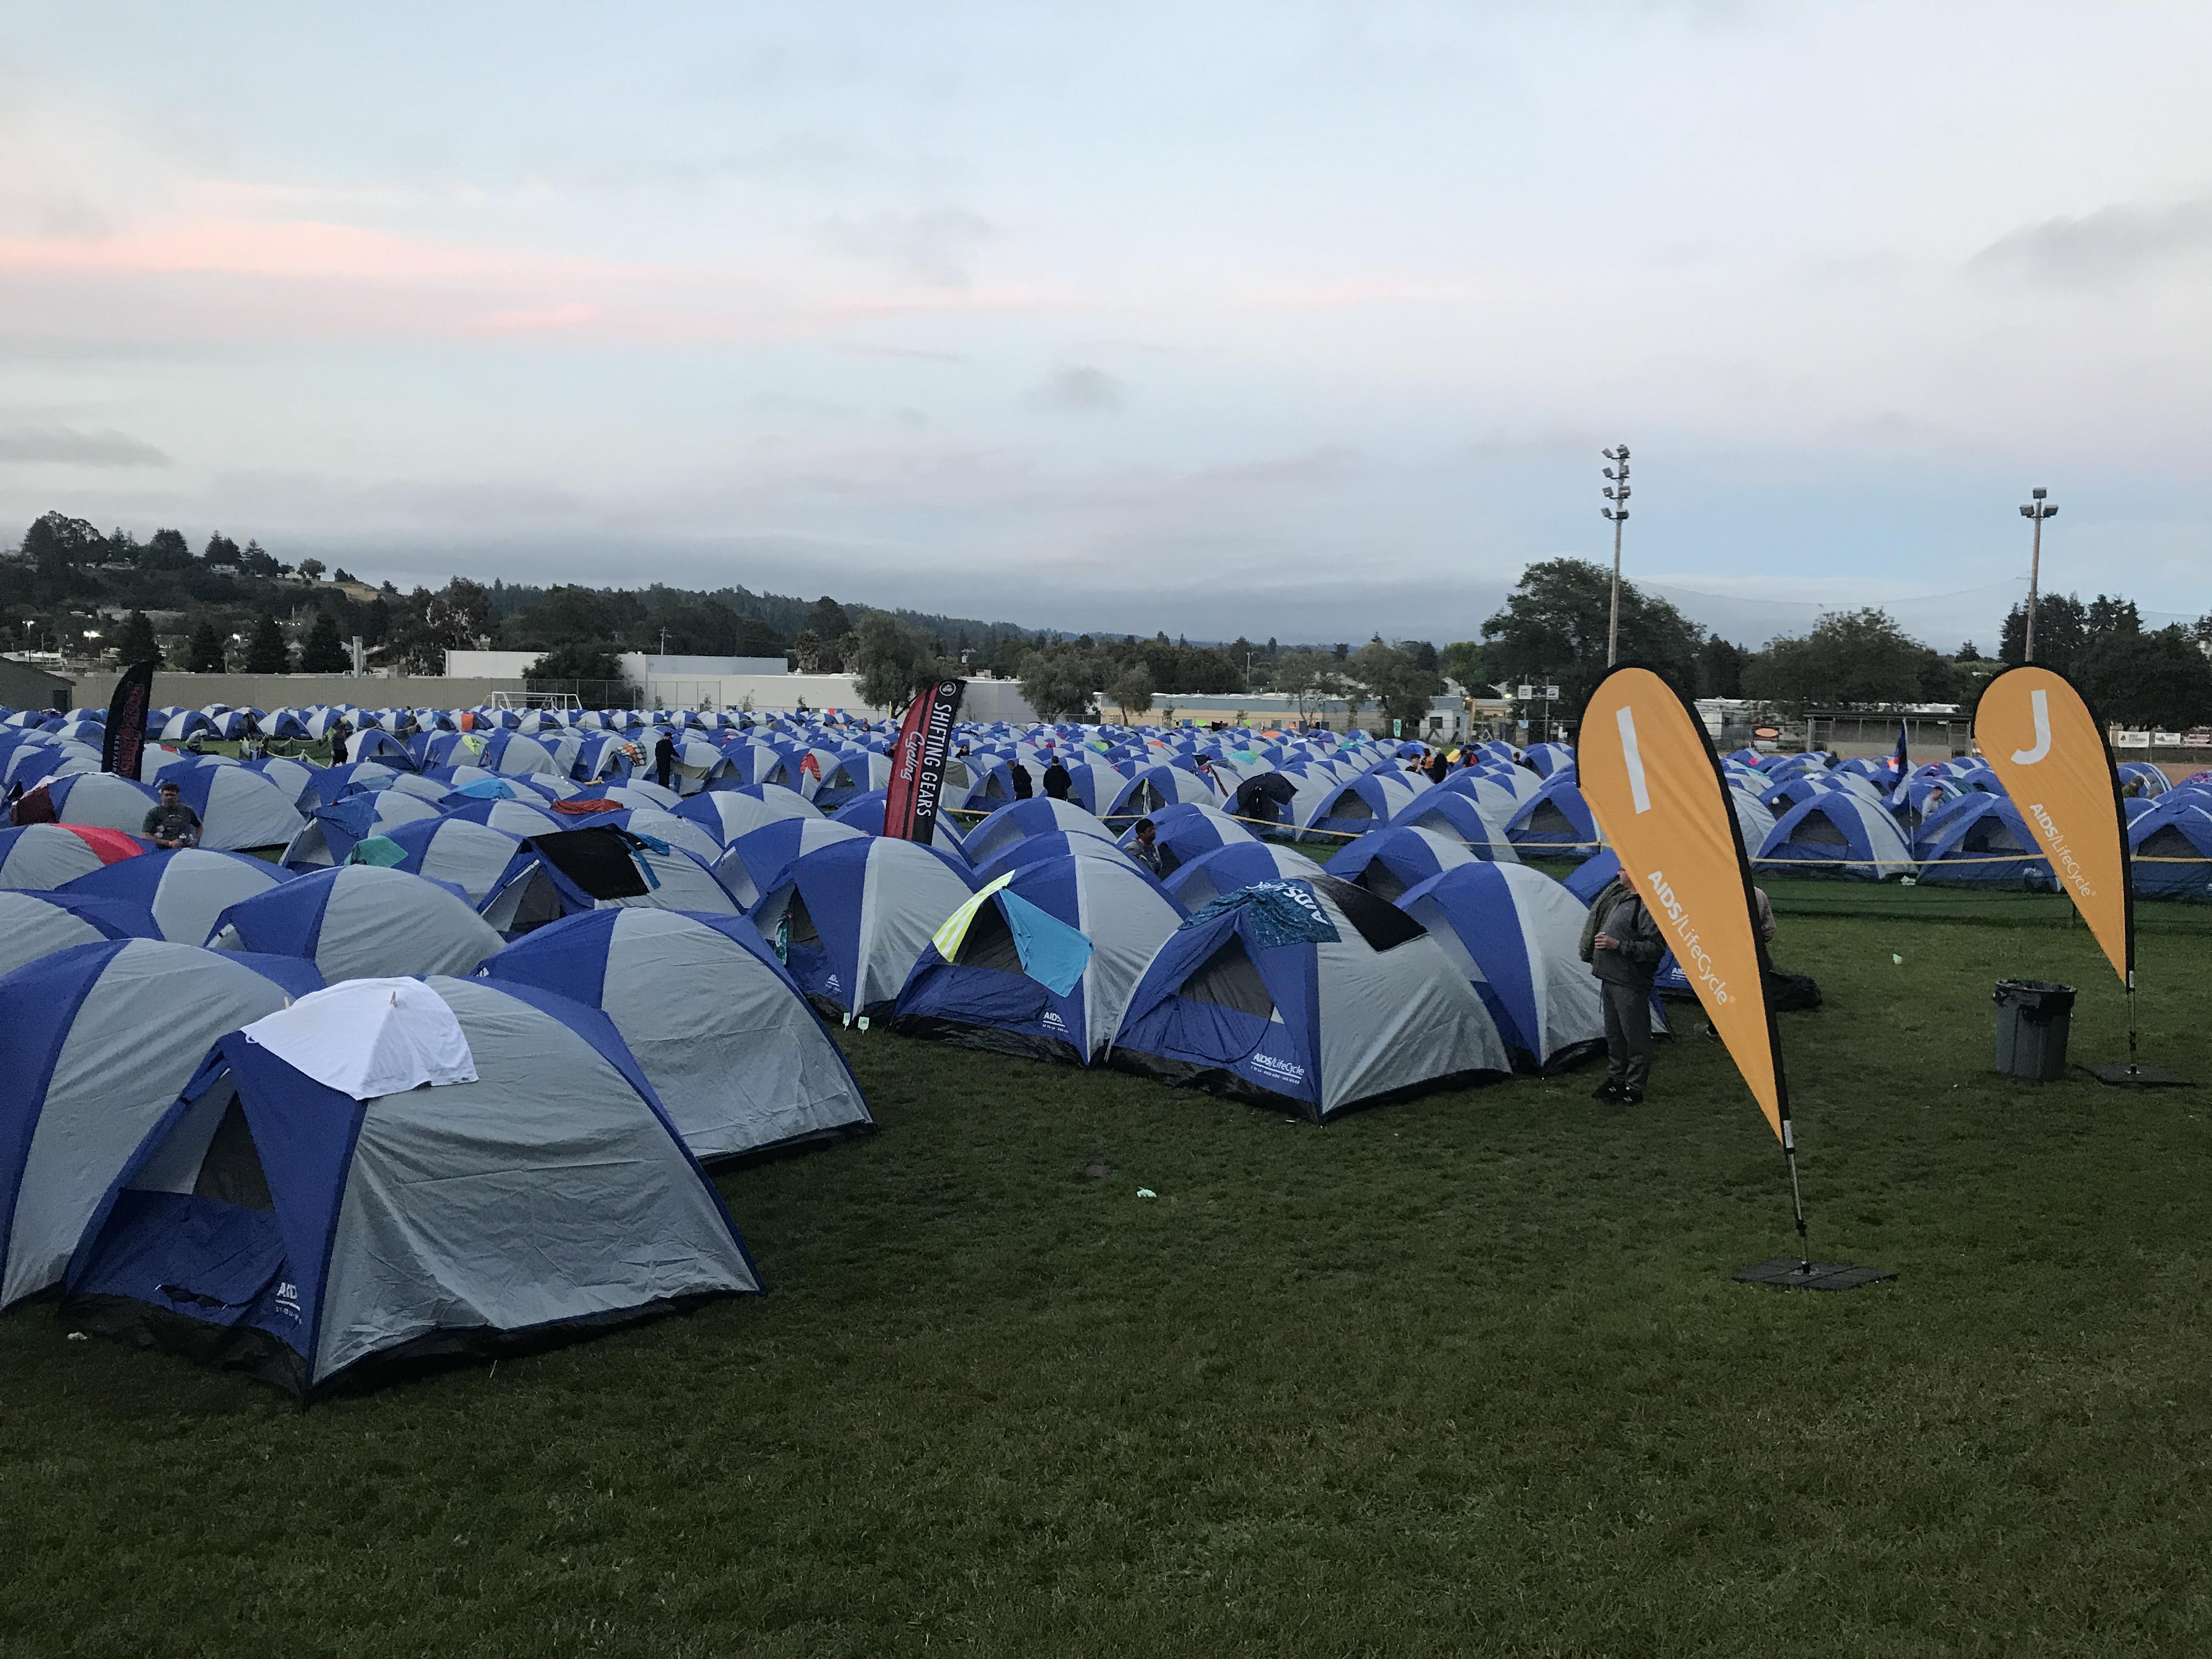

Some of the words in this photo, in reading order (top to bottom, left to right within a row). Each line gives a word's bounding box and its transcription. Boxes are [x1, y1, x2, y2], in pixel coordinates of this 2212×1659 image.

[924, 702, 952, 768] SHIFTING
[2011, 689, 2052, 765] J
[900, 731, 925, 782] Cycling
[1616, 706, 1651, 815] I
[916, 772, 938, 816] GEARS
[1253, 1053, 1305, 1076] AIDS/LifeCycle
